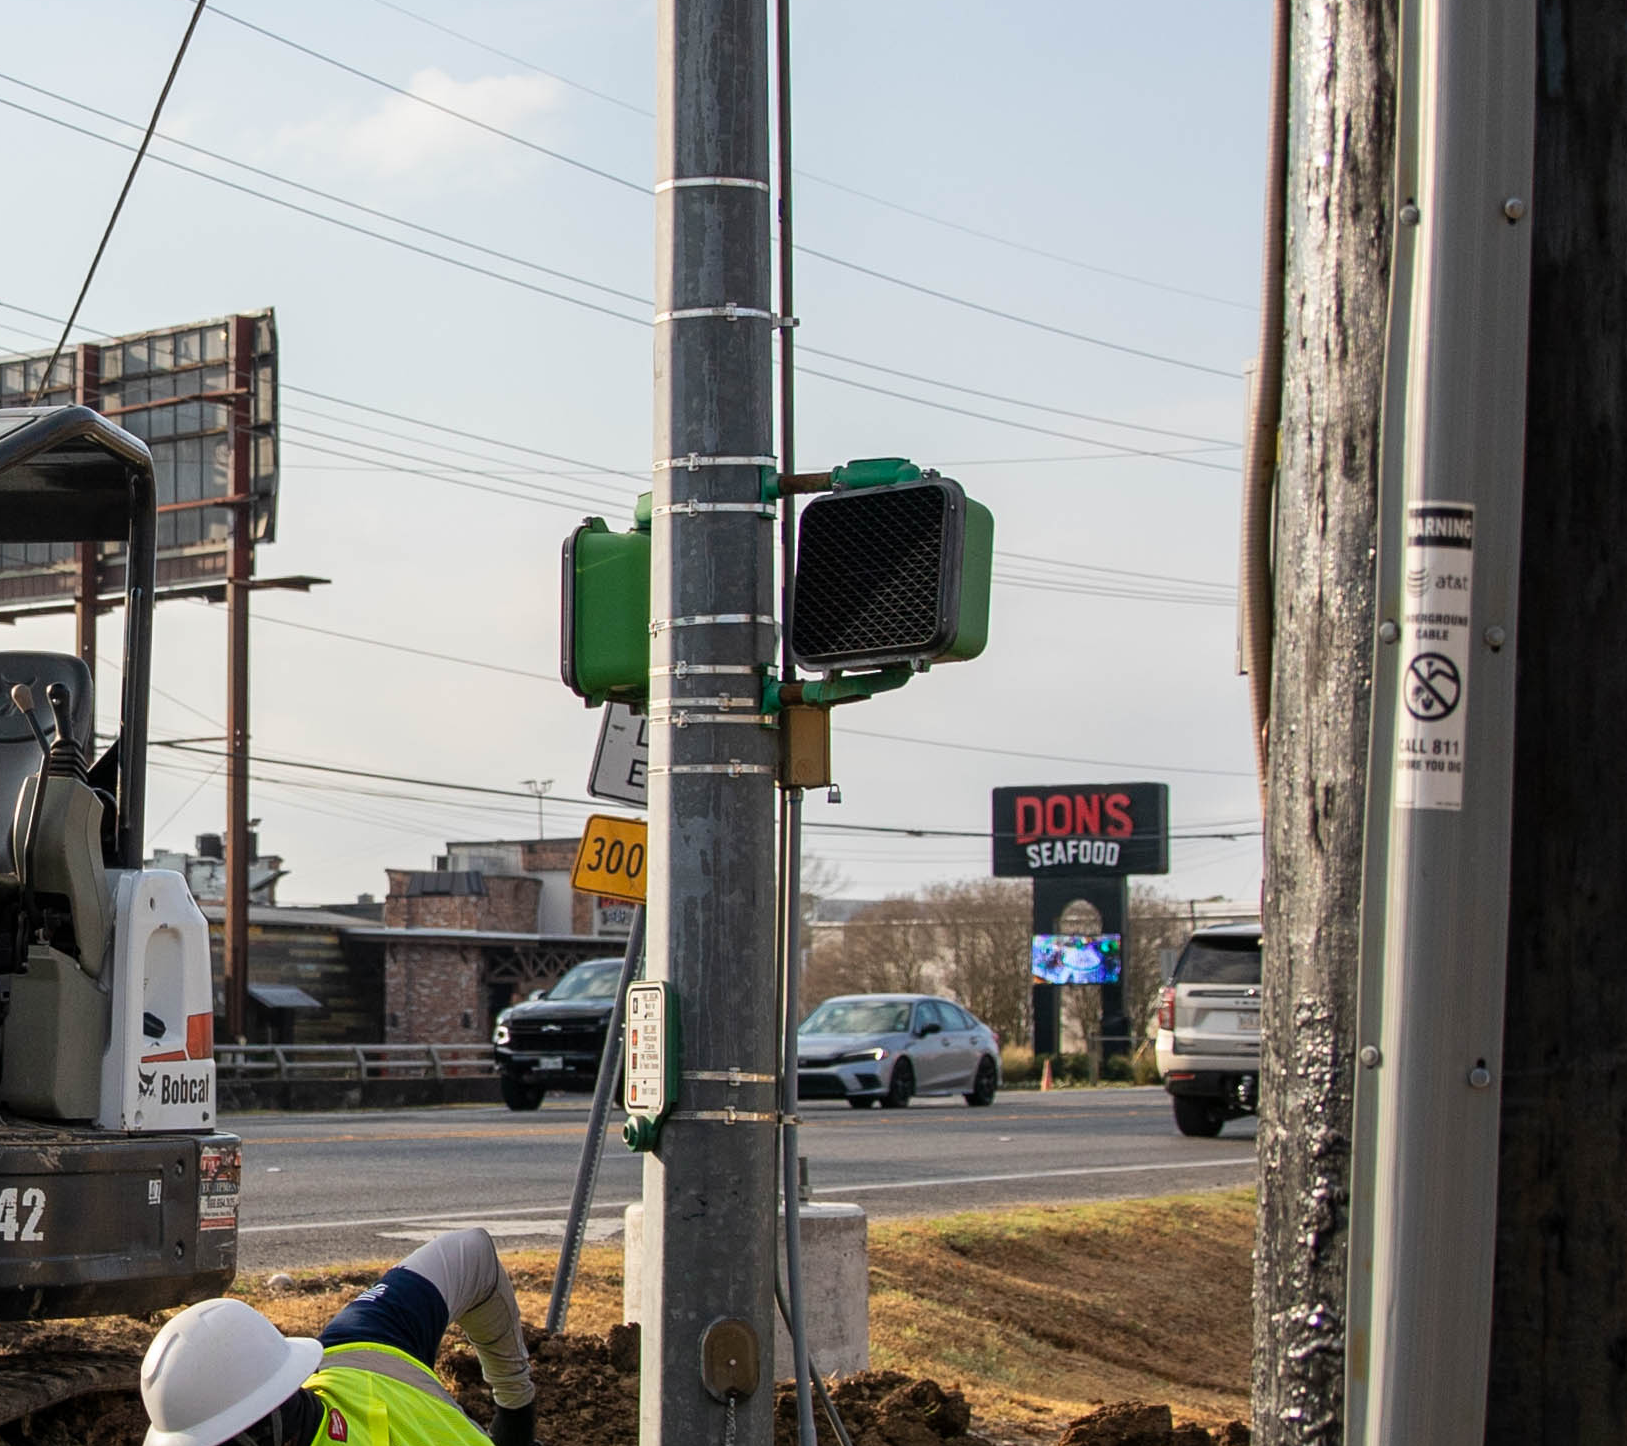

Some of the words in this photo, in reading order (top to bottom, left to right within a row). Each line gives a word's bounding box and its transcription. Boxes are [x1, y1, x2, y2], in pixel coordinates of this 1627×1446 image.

[1432, 739, 1459, 756] 811
[1425, 760, 1445, 772] YOU
[1016, 793, 1134, 844] DON'S
[586, 837, 644, 878] 300
[1026, 840, 1121, 868] SEAFOOD
[161, 1073, 209, 1105] Bobcat
